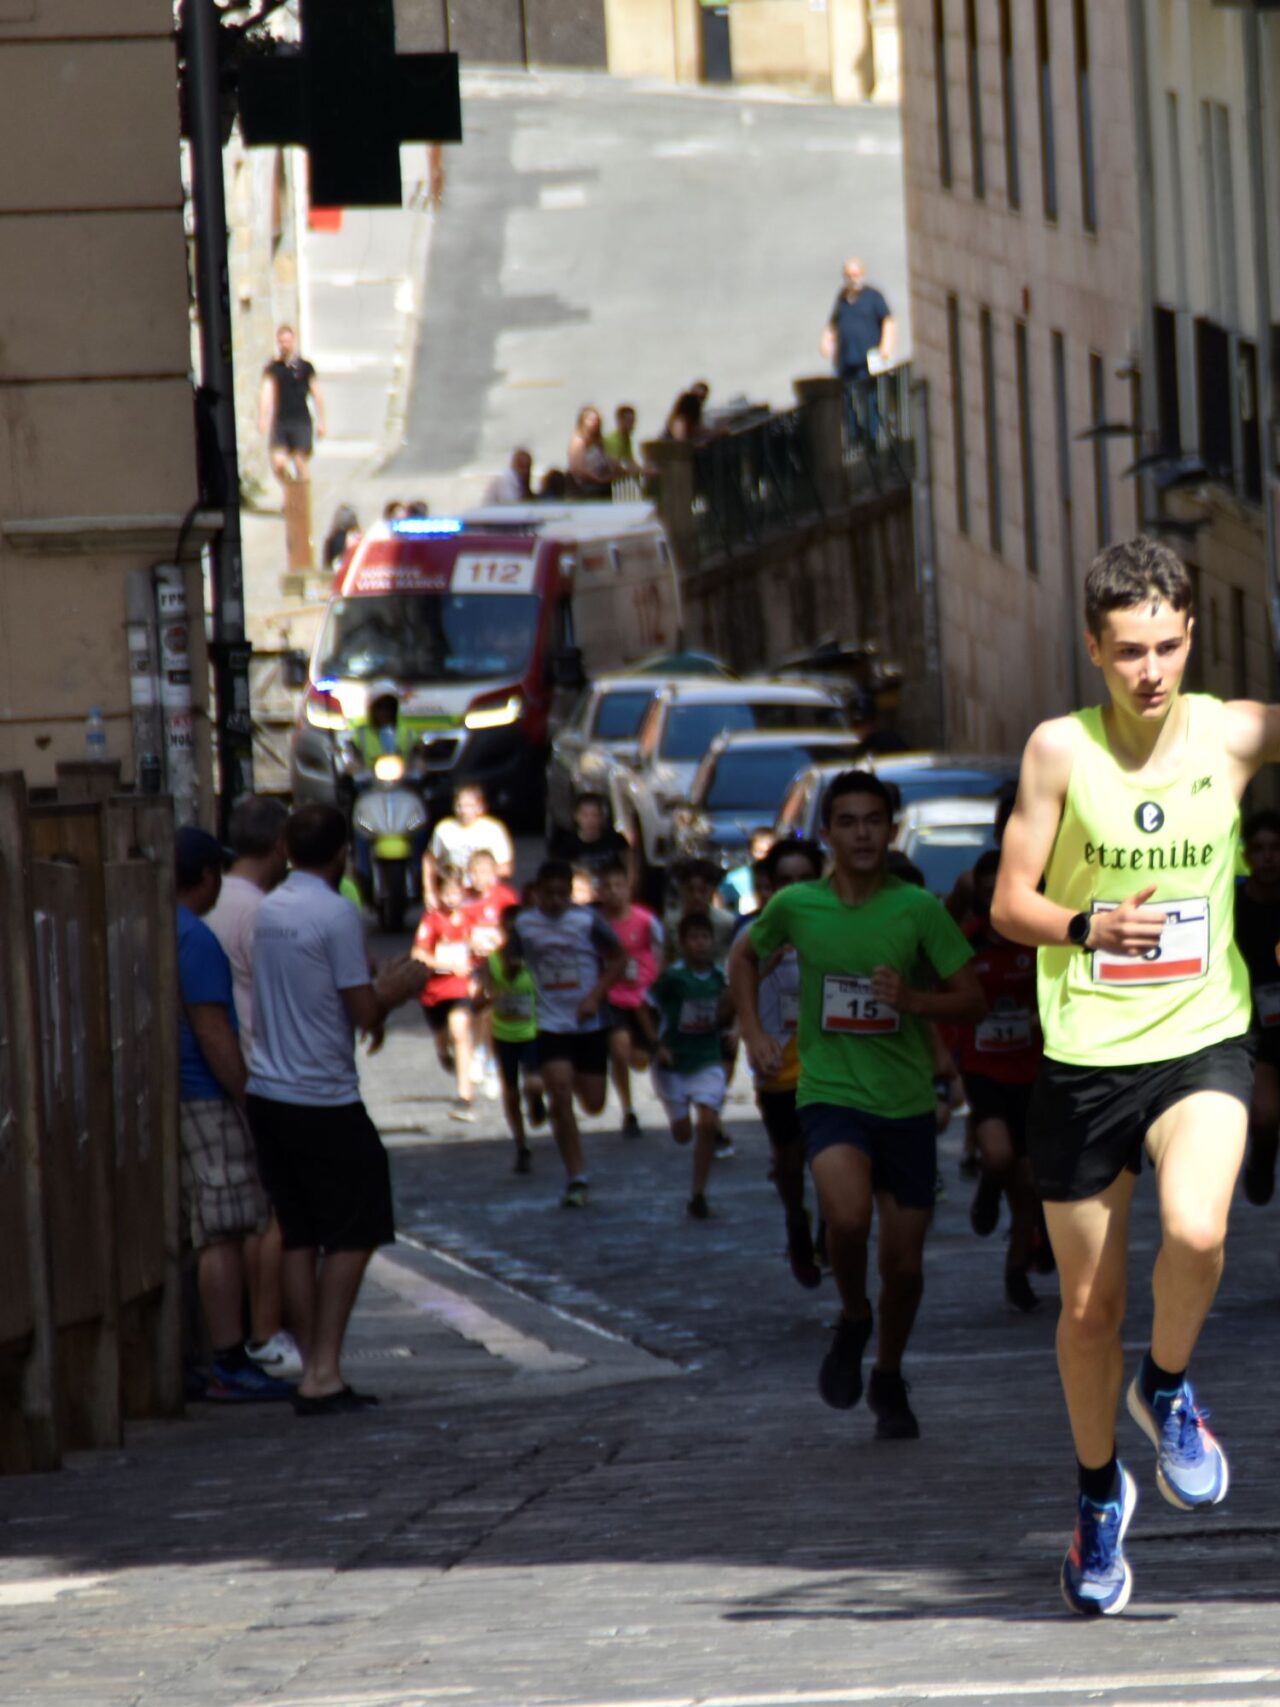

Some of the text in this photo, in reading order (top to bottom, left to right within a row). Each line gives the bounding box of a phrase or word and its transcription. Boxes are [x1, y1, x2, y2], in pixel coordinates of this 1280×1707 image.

[470, 562, 522, 585] 112
[1084, 838, 1214, 870] etxenike
[847, 998, 879, 1019] 15
